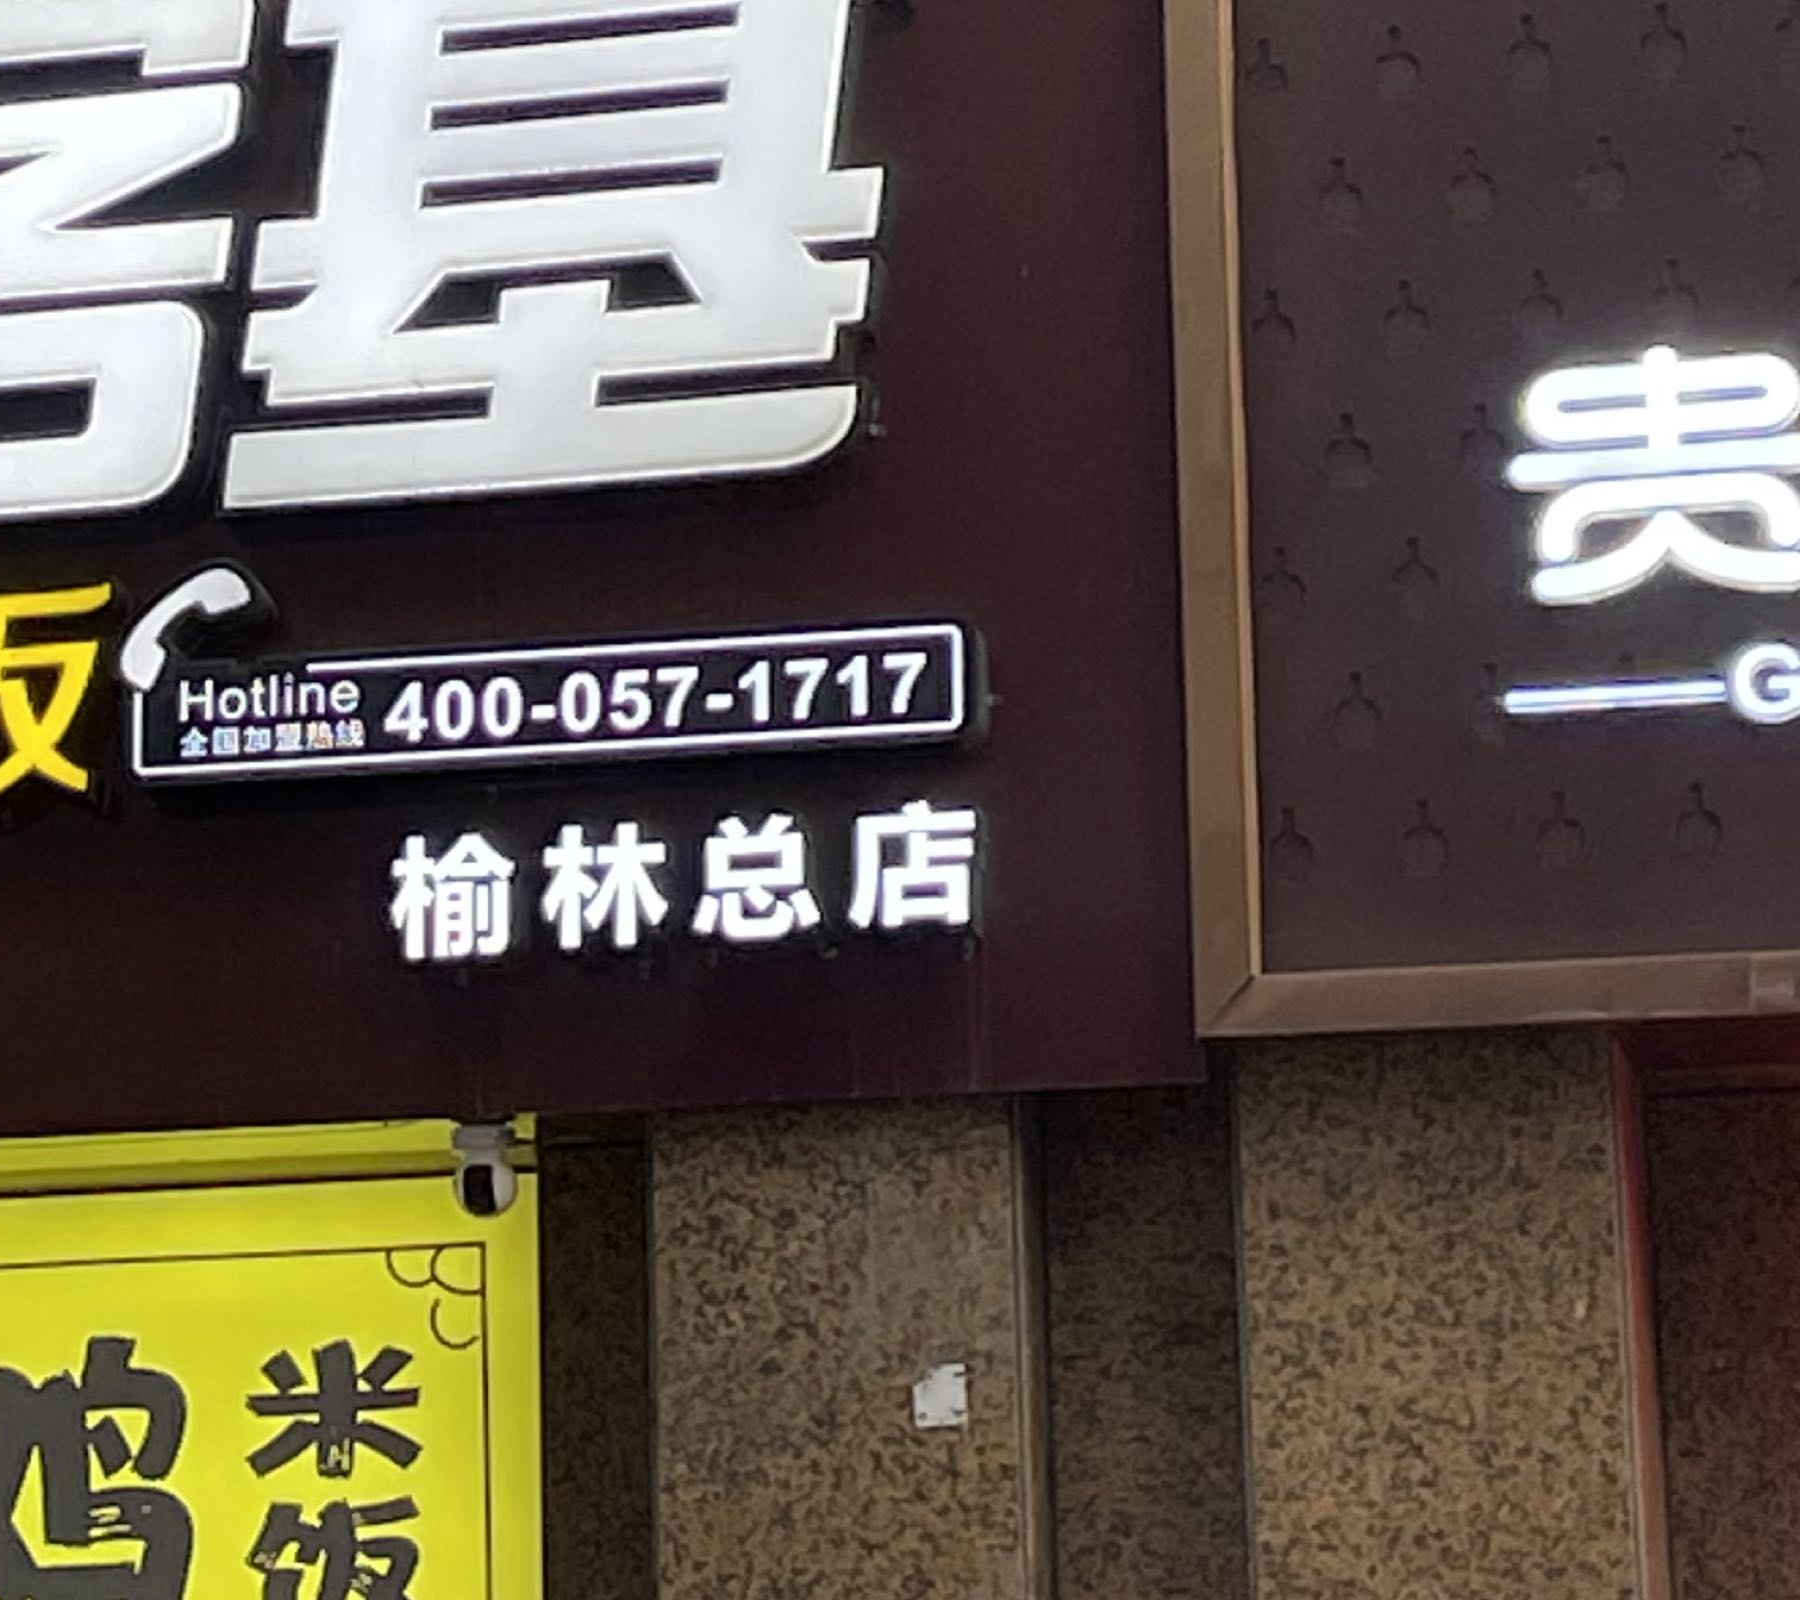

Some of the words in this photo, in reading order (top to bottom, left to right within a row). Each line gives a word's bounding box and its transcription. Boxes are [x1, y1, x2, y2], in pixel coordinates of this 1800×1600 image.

[1508, 345, 1800, 606] 贵
[177, 671, 361, 723] Hotline
[384, 652, 929, 744] 400-057-1717
[390, 800, 978, 962] 榆林总店
